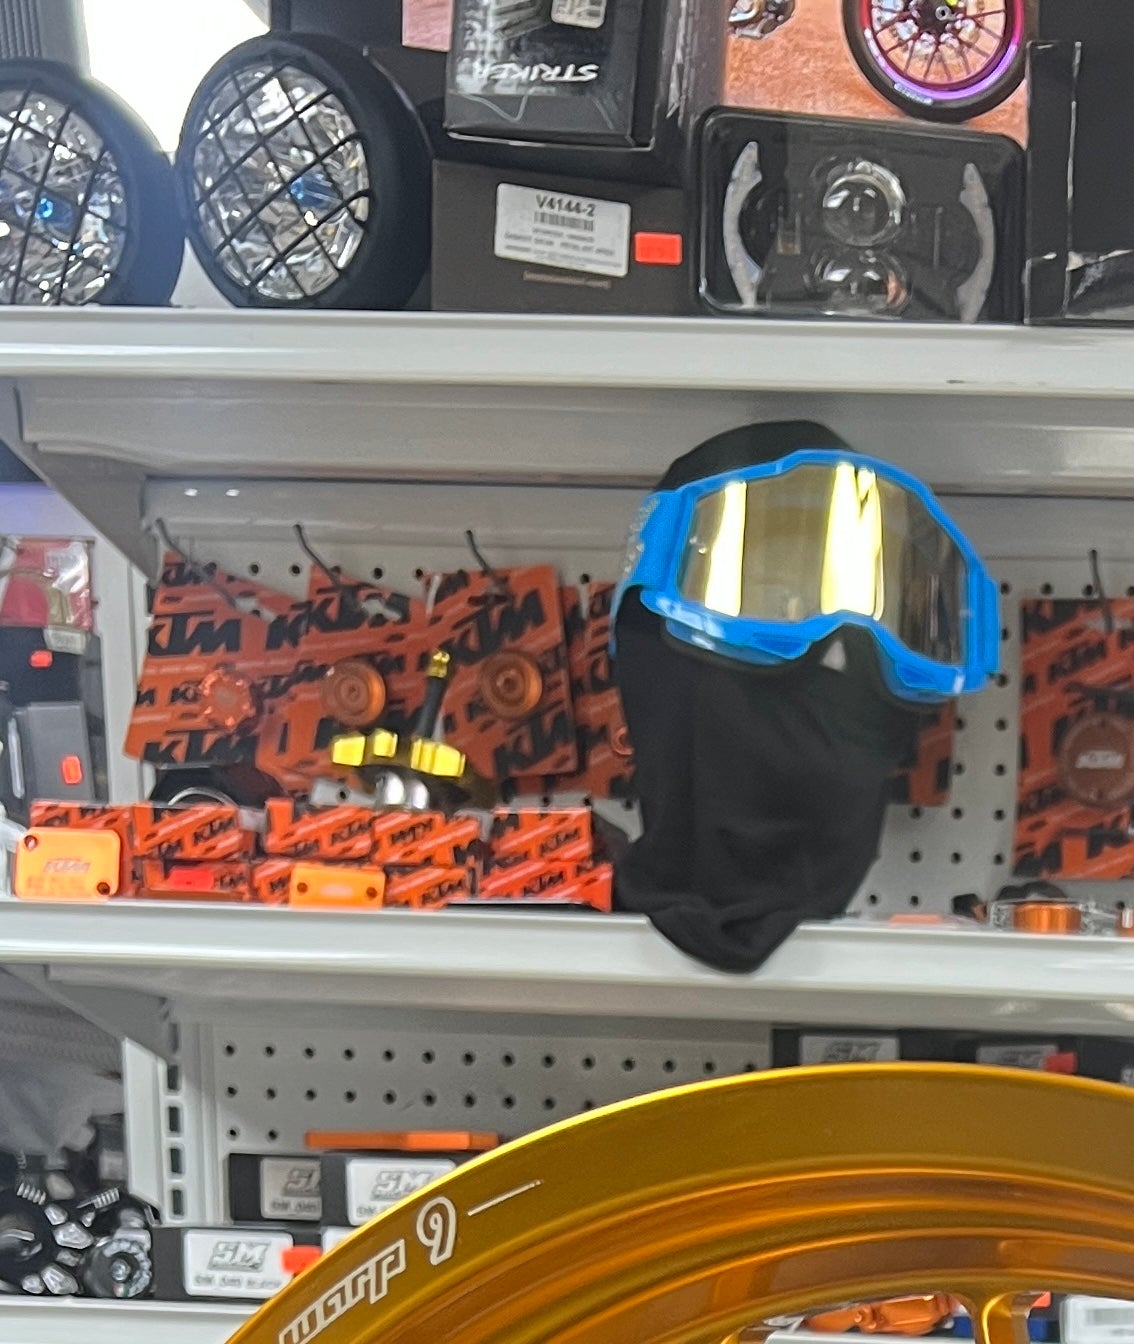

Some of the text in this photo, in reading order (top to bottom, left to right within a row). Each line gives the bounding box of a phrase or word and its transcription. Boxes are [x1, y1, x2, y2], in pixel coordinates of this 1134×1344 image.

[473, 62, 600, 82] STRIKER
[416, 1196, 457, 1266] 9
[207, 1241, 271, 1273] SM
